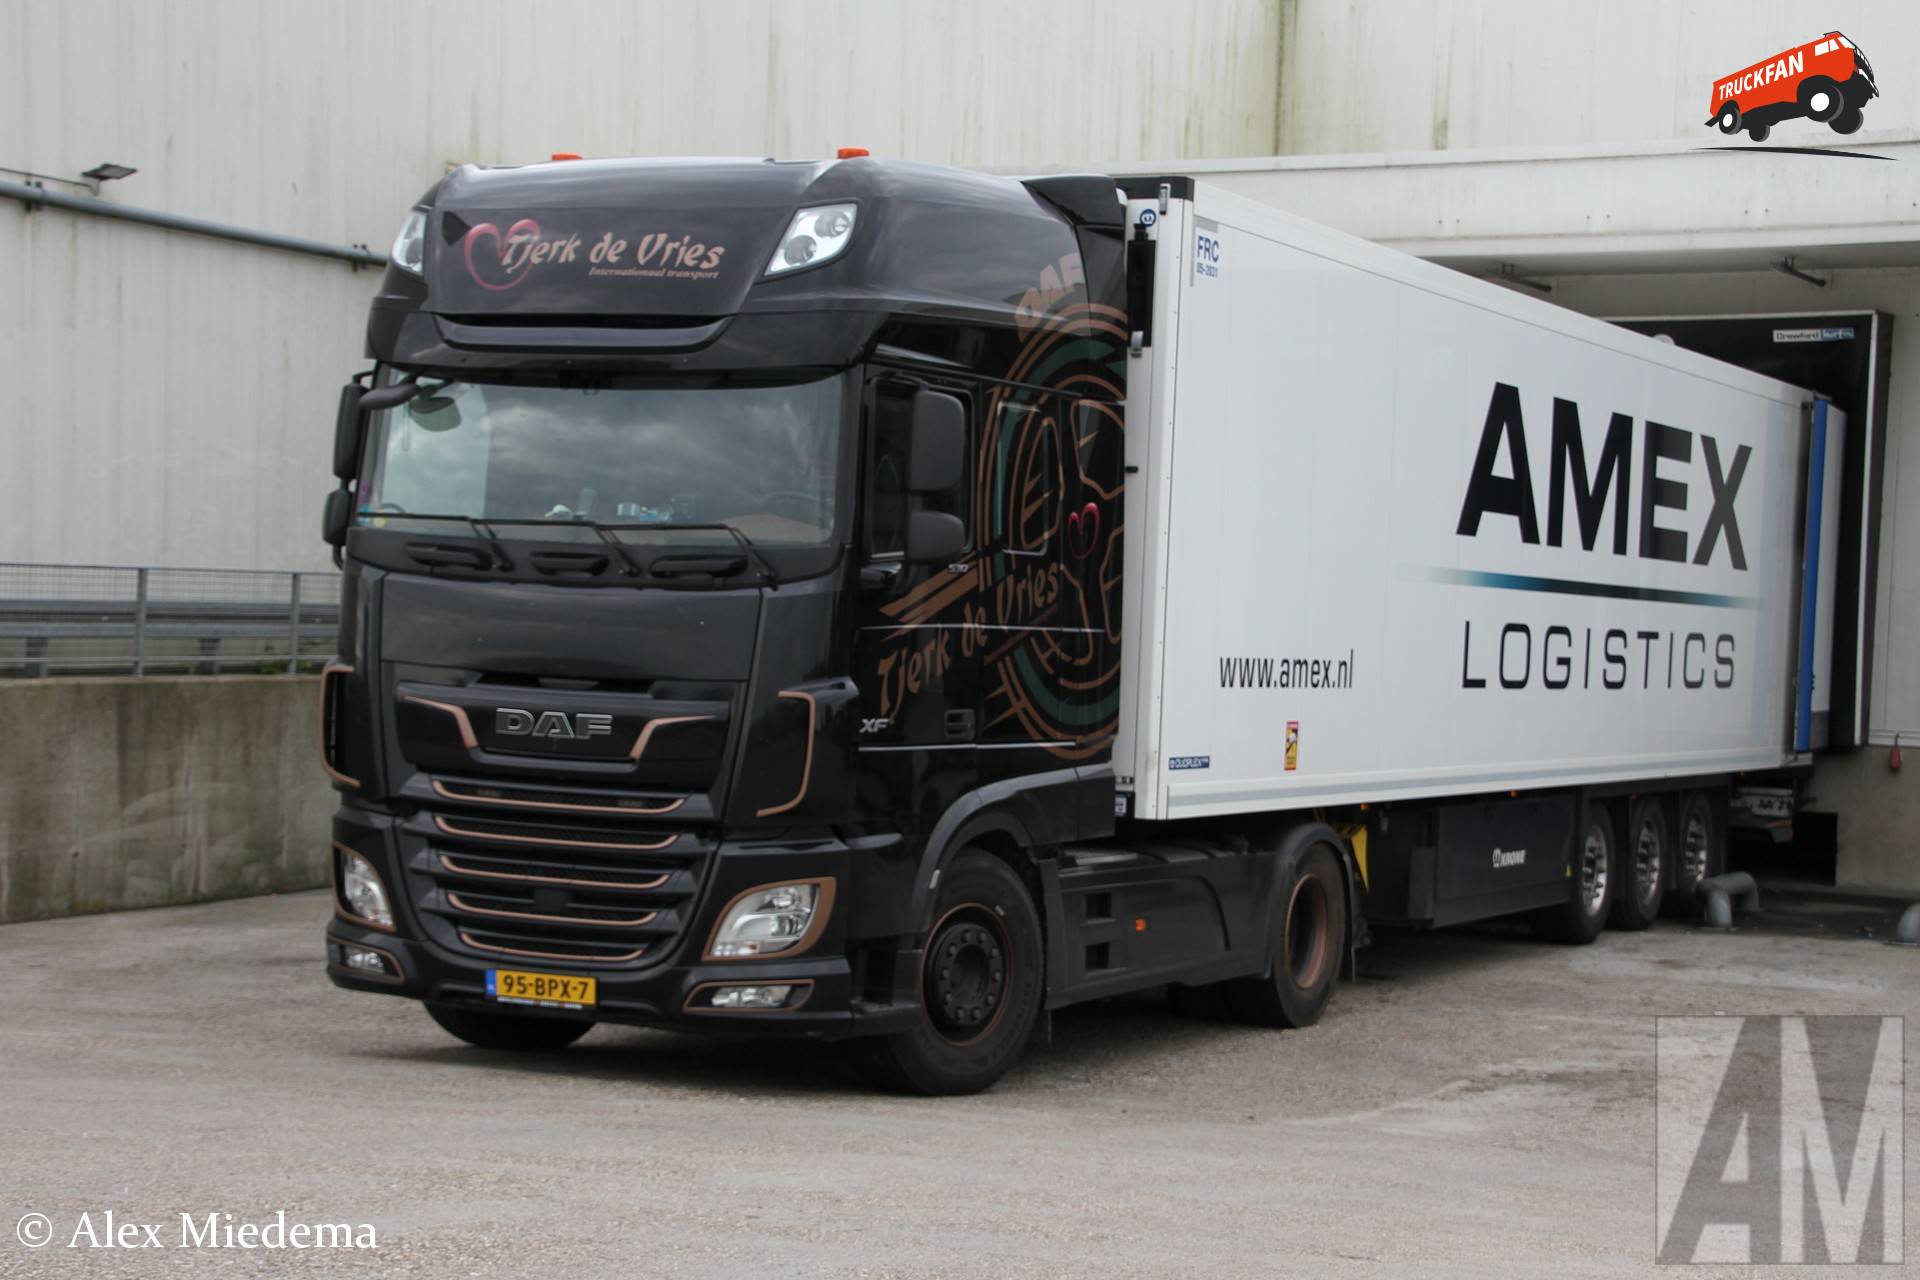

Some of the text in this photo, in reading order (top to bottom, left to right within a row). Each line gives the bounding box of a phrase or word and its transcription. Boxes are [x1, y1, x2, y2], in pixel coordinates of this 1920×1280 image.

[501, 232, 726, 274] Tjerk de Vries
[1196, 235, 1220, 263] FRC
[667, 269, 720, 281] transport
[1015, 252, 1086, 343] DAF
[1456, 381, 1753, 572] AMEX
[878, 623, 951, 725] Tjerk
[961, 602, 988, 657] de
[996, 562, 1061, 632] Vries
[1462, 620, 1736, 690] LOGISTICS
[1219, 648, 1354, 689] www.amex.nl
[495, 707, 614, 740] DAF
[859, 718, 889, 733] XF
[503, 974, 589, 1000] 95-BPX-7
